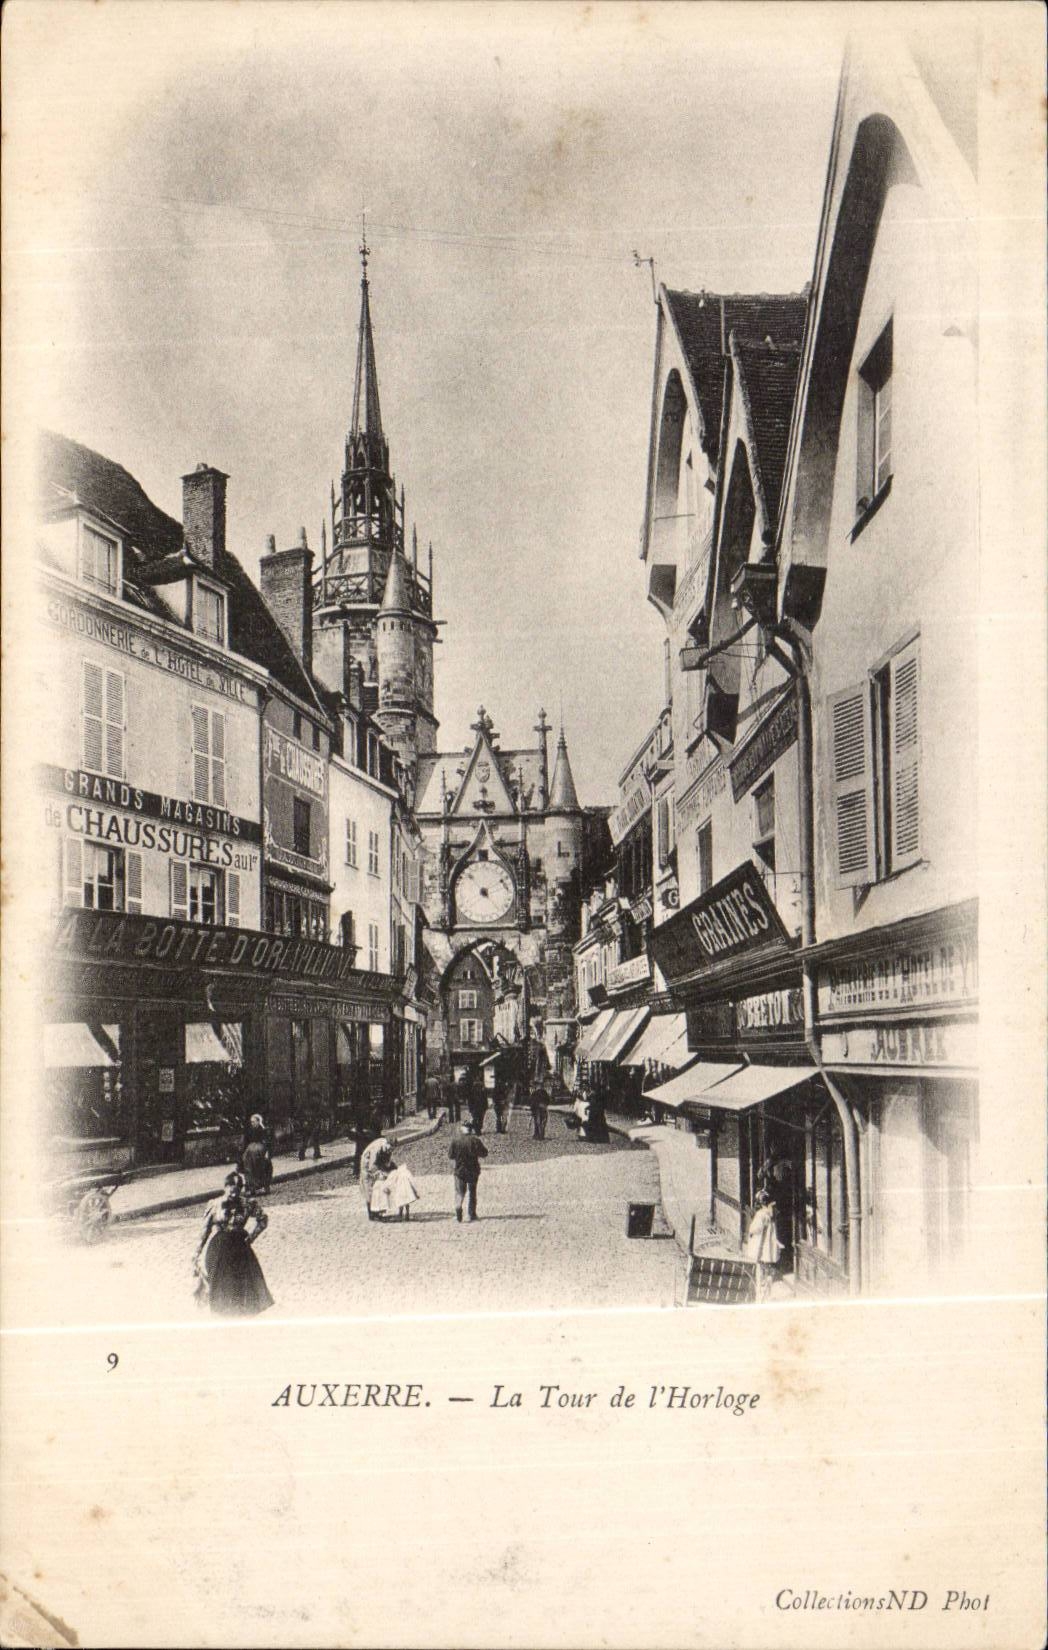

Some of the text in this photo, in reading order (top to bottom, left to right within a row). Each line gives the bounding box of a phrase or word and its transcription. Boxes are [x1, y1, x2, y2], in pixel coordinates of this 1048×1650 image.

[64, 769, 241, 836] GRANDS MAGASINS
[66, 803, 234, 867] CHAUSSURES
[692, 881, 769, 956] GRAINES
